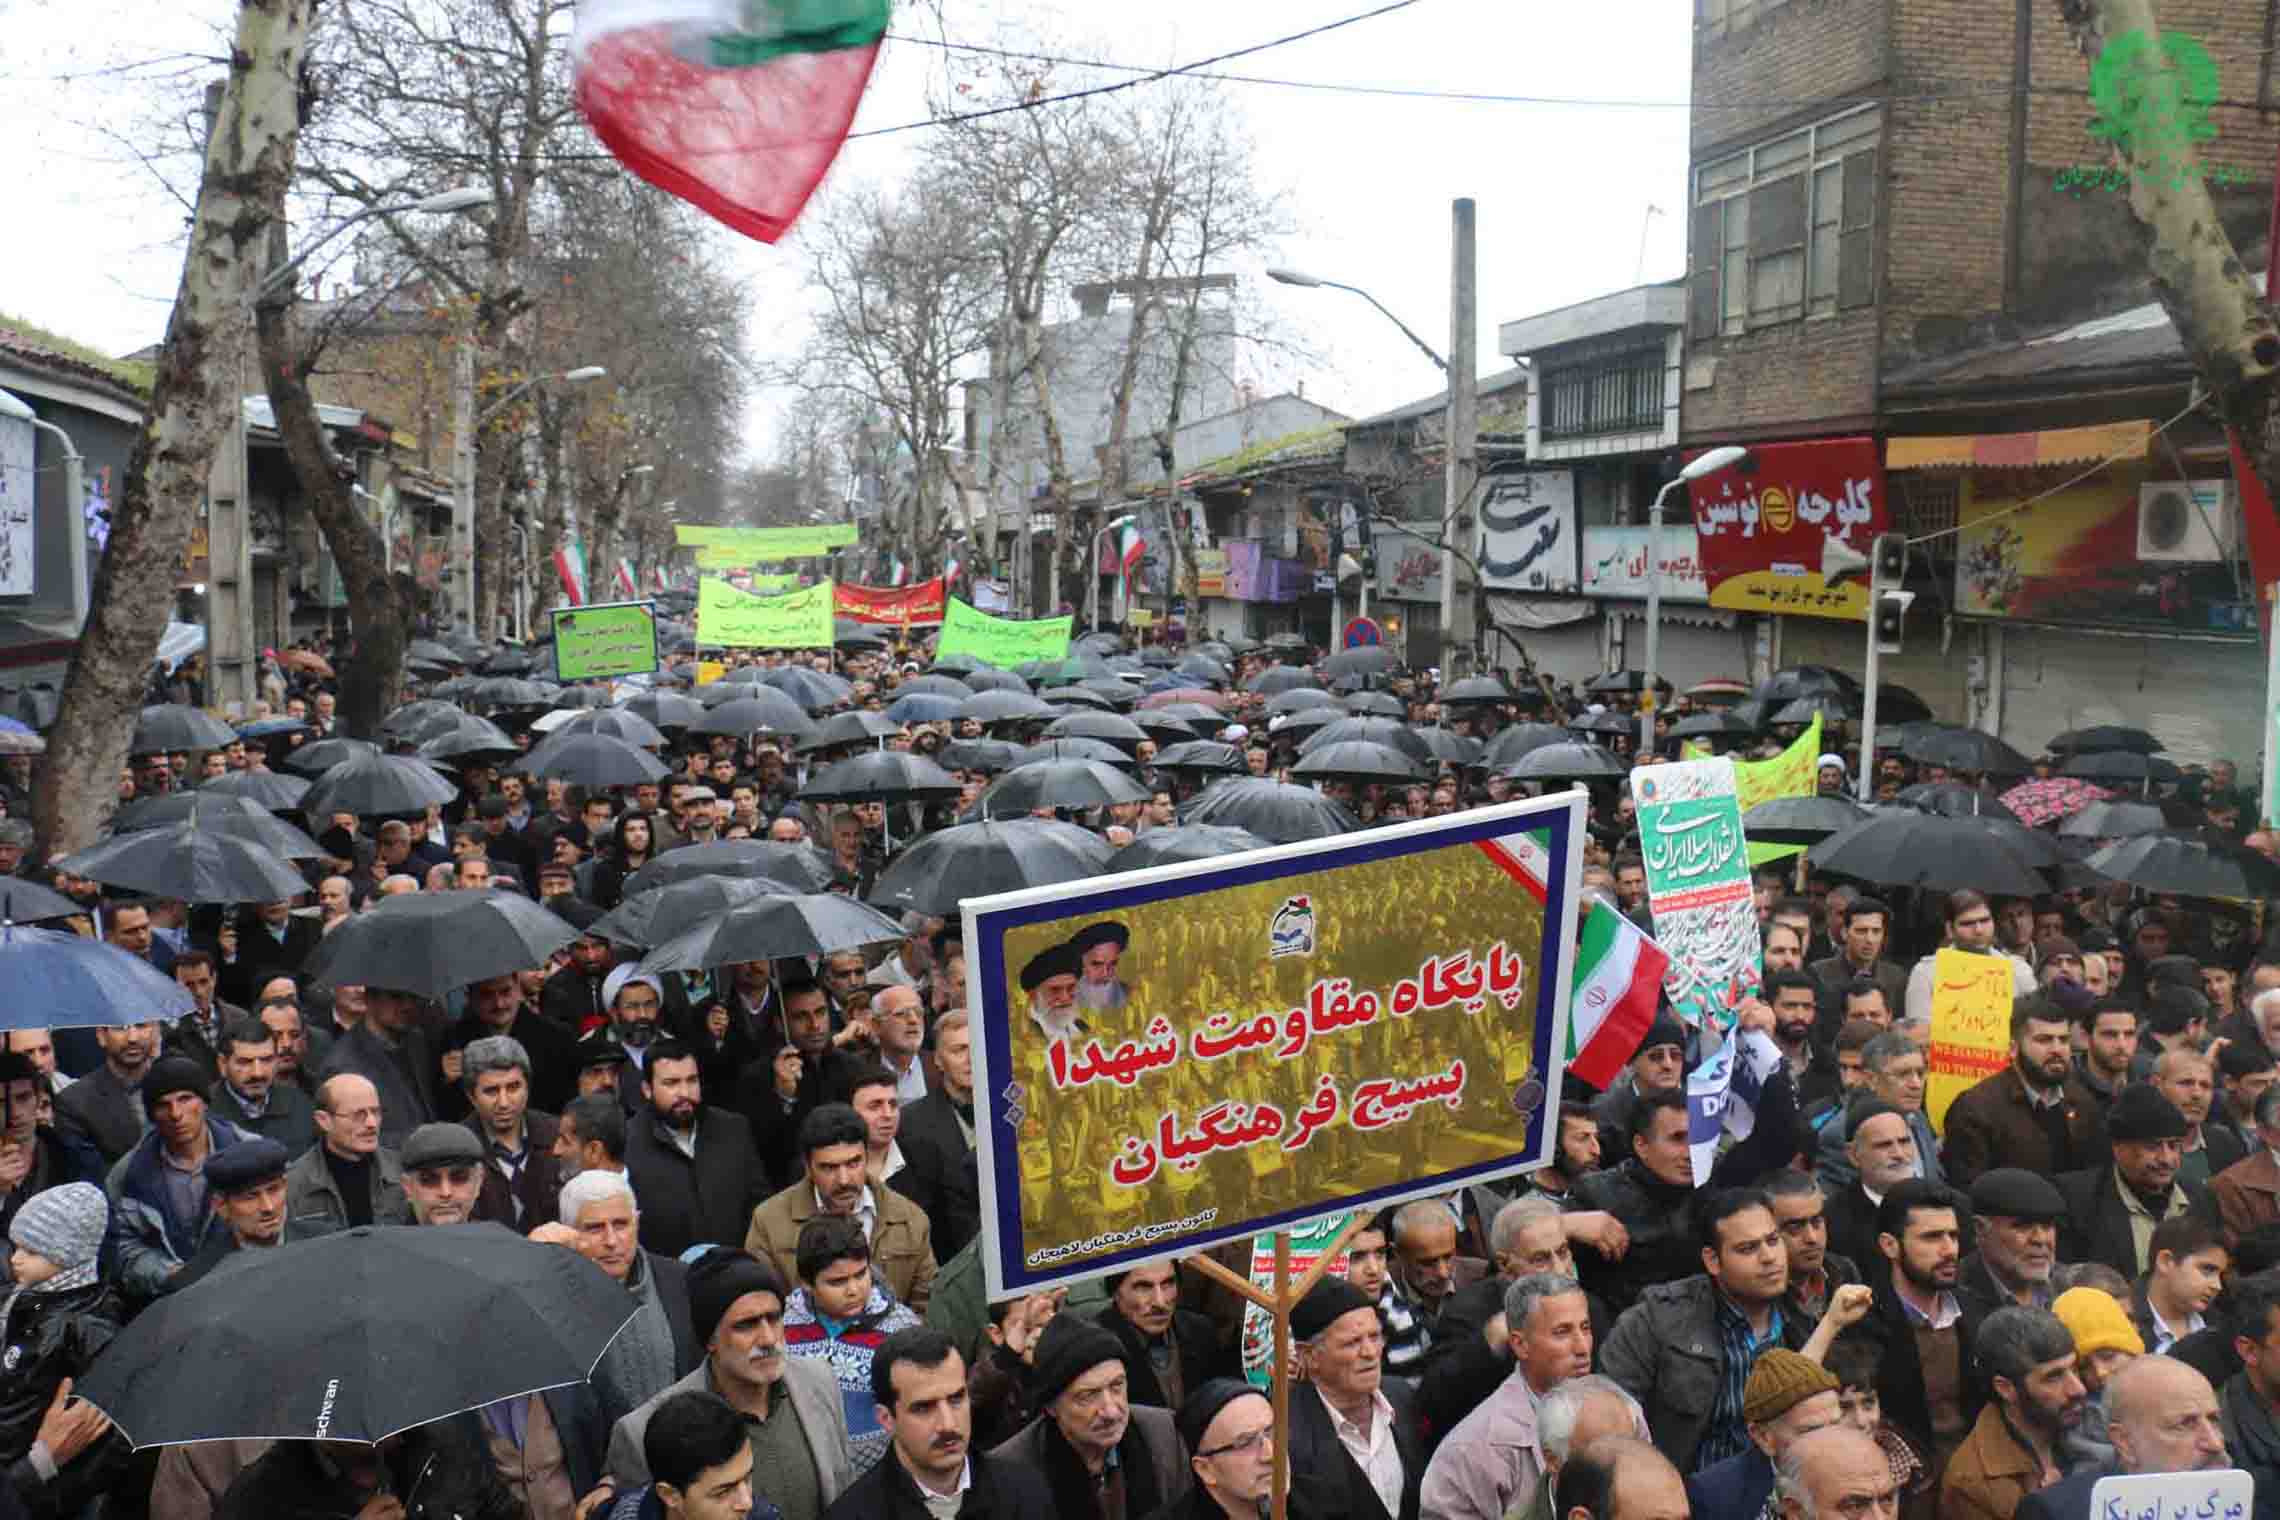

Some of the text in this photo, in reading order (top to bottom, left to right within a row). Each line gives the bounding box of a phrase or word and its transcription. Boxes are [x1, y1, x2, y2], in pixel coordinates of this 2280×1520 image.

[1696, 479, 1872, 539] کلوچه نوشین
[1048, 944, 1521, 1087] پایگاه مقاومت شهدا
[1112, 1061, 1464, 1184] بسیج فرهنگیان
[1028, 1208, 1217, 1265] کانون بسیج فرهنگیان لاهیجان
[2195, 1487, 2243, 1520] مرگ
